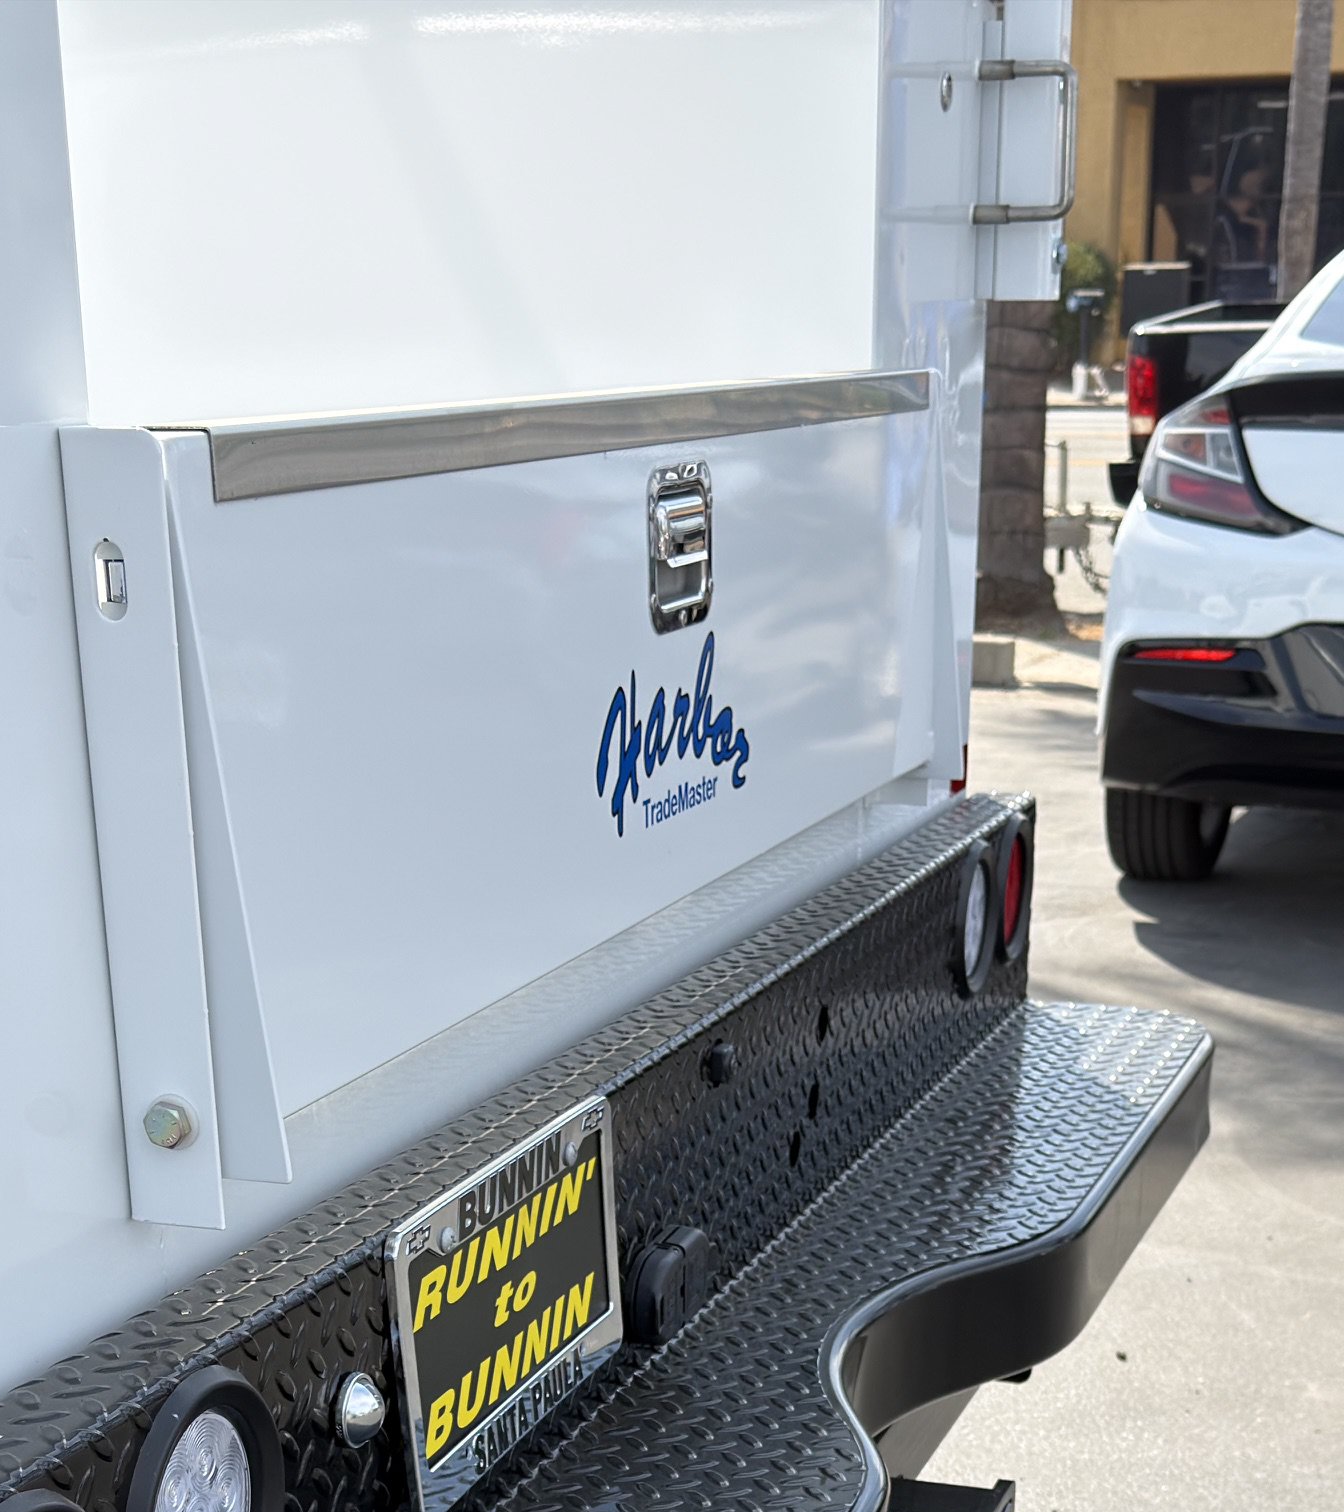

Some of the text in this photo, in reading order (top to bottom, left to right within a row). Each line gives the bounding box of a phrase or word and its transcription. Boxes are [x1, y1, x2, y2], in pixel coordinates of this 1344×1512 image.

[596, 630, 750, 838] Harbor
[642, 775, 718, 829] TradeMaster
[412, 1157, 597, 1334] RUNNIN'
[458, 1129, 562, 1243] BUNNIN
[494, 1270, 537, 1328] to
[425, 1271, 595, 1460] BUNNIN
[472, 1345, 584, 1475] SANTA PAULA
